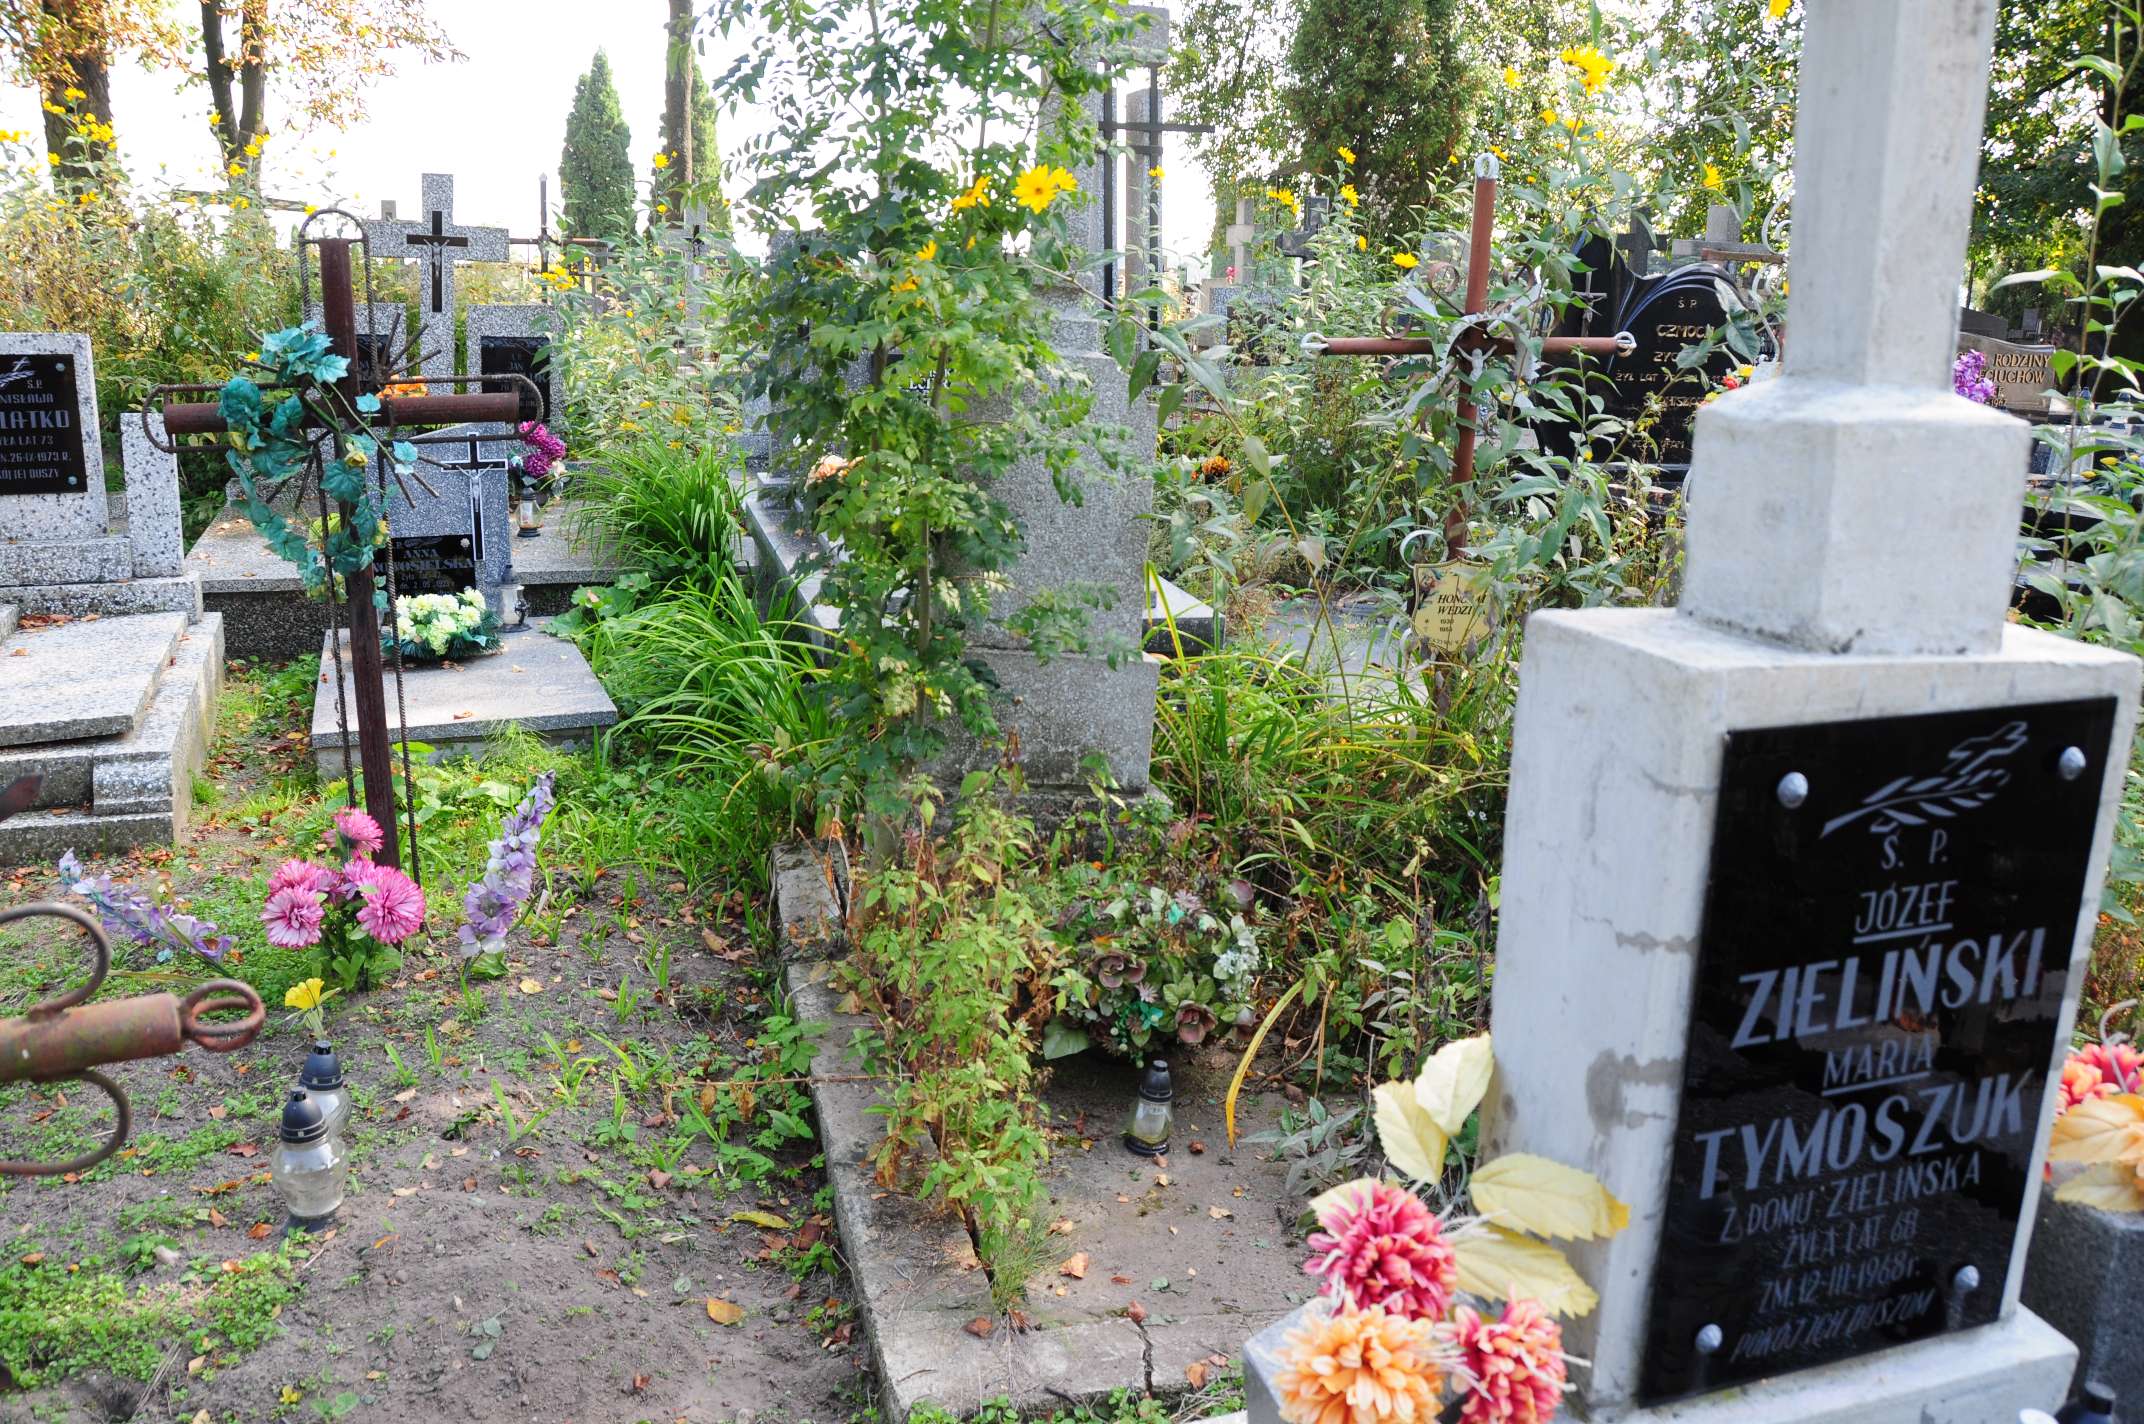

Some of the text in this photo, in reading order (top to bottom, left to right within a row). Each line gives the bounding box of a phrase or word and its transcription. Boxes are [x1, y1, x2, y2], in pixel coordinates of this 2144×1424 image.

[1994, 352, 2051, 368] RODZINY
[403, 549, 438, 558] ANNA
[1928, 829, 1948, 865] P.
[1854, 880, 1959, 935] JÓZEF
[1730, 927, 2046, 1049] ZIELIŃSKI
[1822, 1033, 1934, 1088] MARIA
[1695, 1067, 2035, 1200] TYMOSZUK
[1747, 1189, 1815, 1236] DOMU
[1826, 1150, 1982, 1218] ZIELIŃSKA
[1846, 1213, 1886, 1252] LAT
